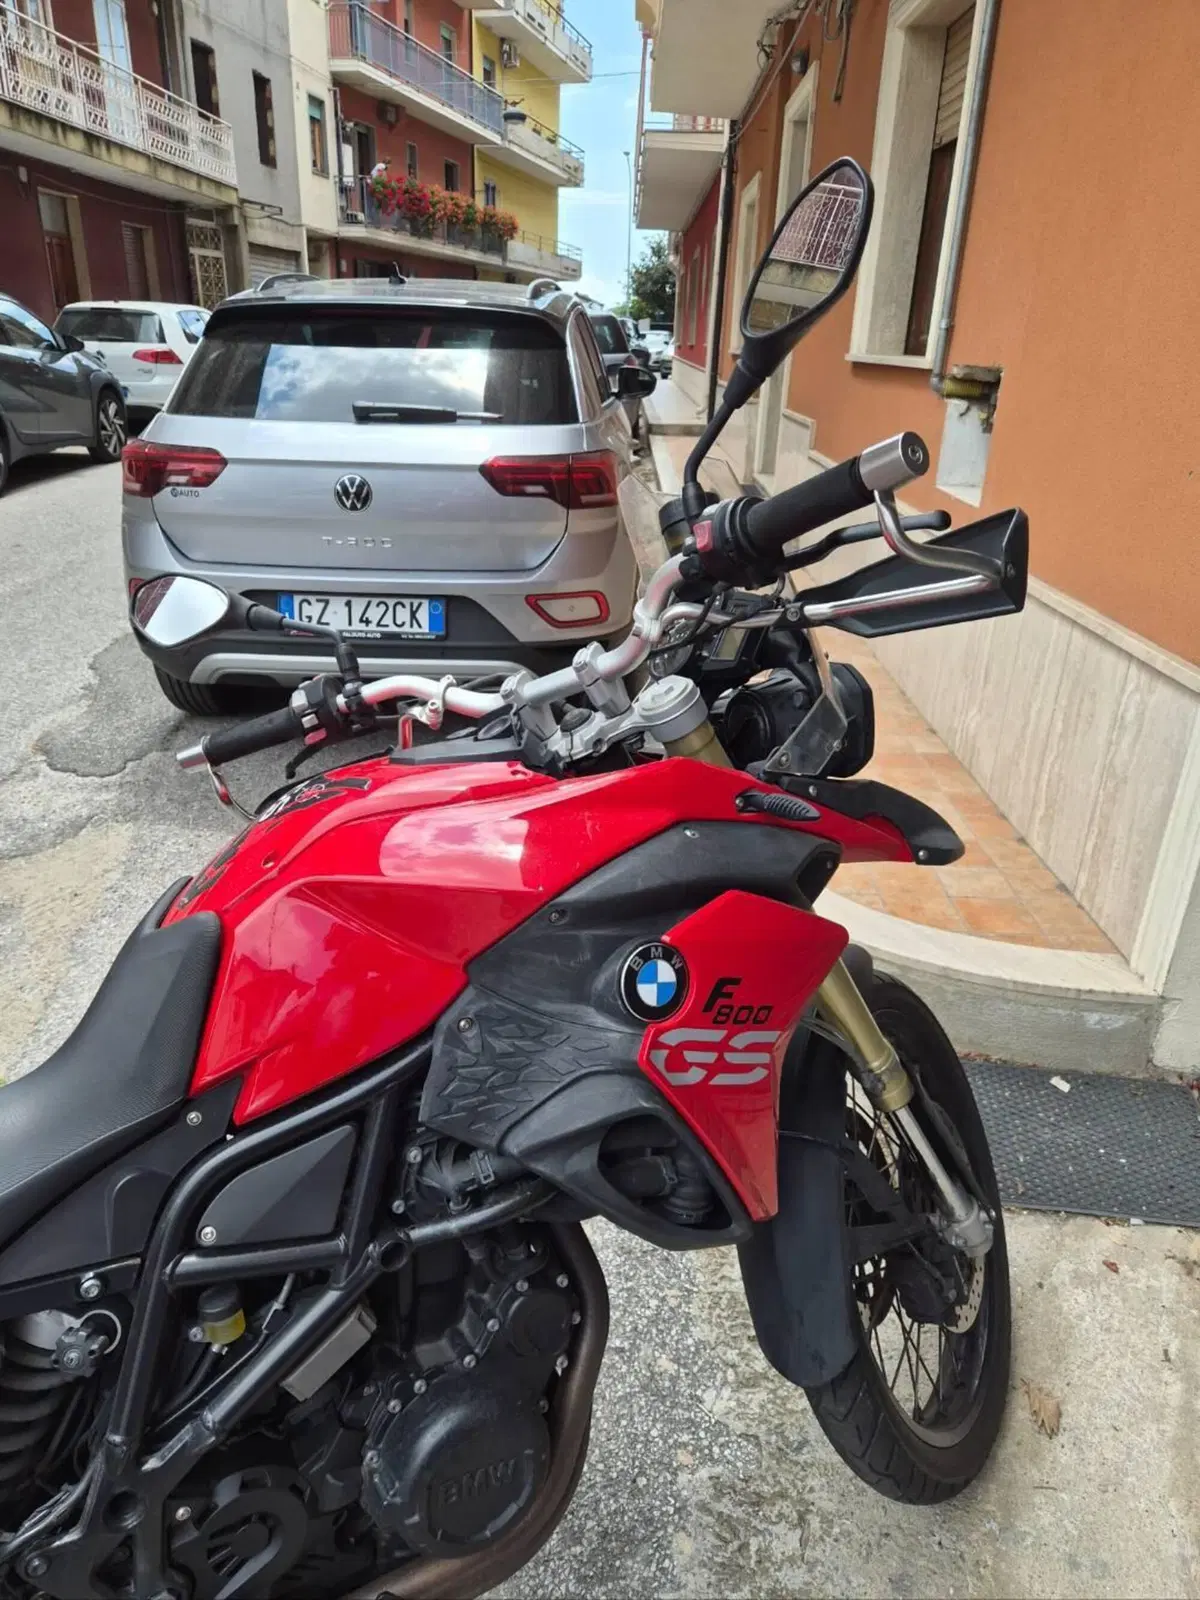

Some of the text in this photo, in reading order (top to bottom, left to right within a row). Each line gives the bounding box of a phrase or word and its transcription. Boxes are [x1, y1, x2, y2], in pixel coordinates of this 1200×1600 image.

[299, 598, 424, 629] GZ 142CK
[630, 946, 683, 971] BMW
[702, 977, 774, 1025] F 800
[650, 1027, 782, 1086] GS
[438, 1457, 517, 1505] BMW
